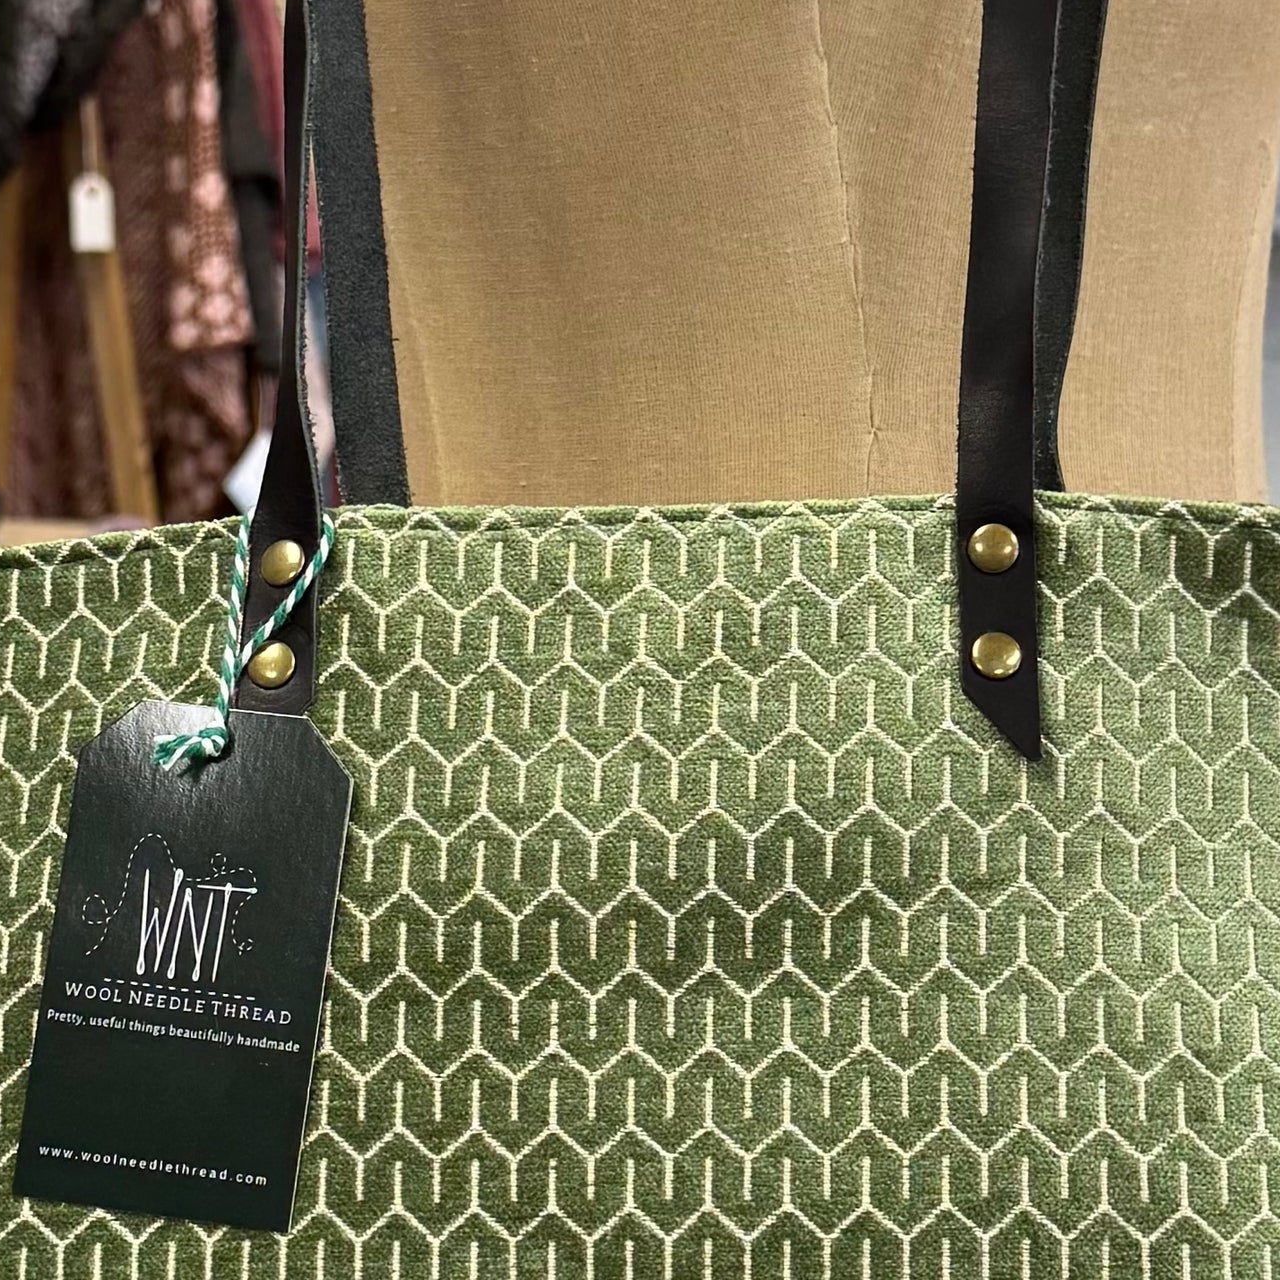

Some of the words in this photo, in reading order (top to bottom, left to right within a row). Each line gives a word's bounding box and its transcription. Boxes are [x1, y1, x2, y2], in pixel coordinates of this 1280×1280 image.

[136, 868, 258, 983] WNT
[64, 981, 122, 1003] WOOL
[128, 990, 206, 1014] NEEDLE
[211, 1000, 293, 1025] THREAD
[89, 1016, 127, 1030] useful
[128, 1020, 166, 1037] things
[169, 1024, 235, 1047] beautifully
[236, 1032, 301, 1054] handmade
[38, 1145, 268, 1187] www.woolneedlethread.com
